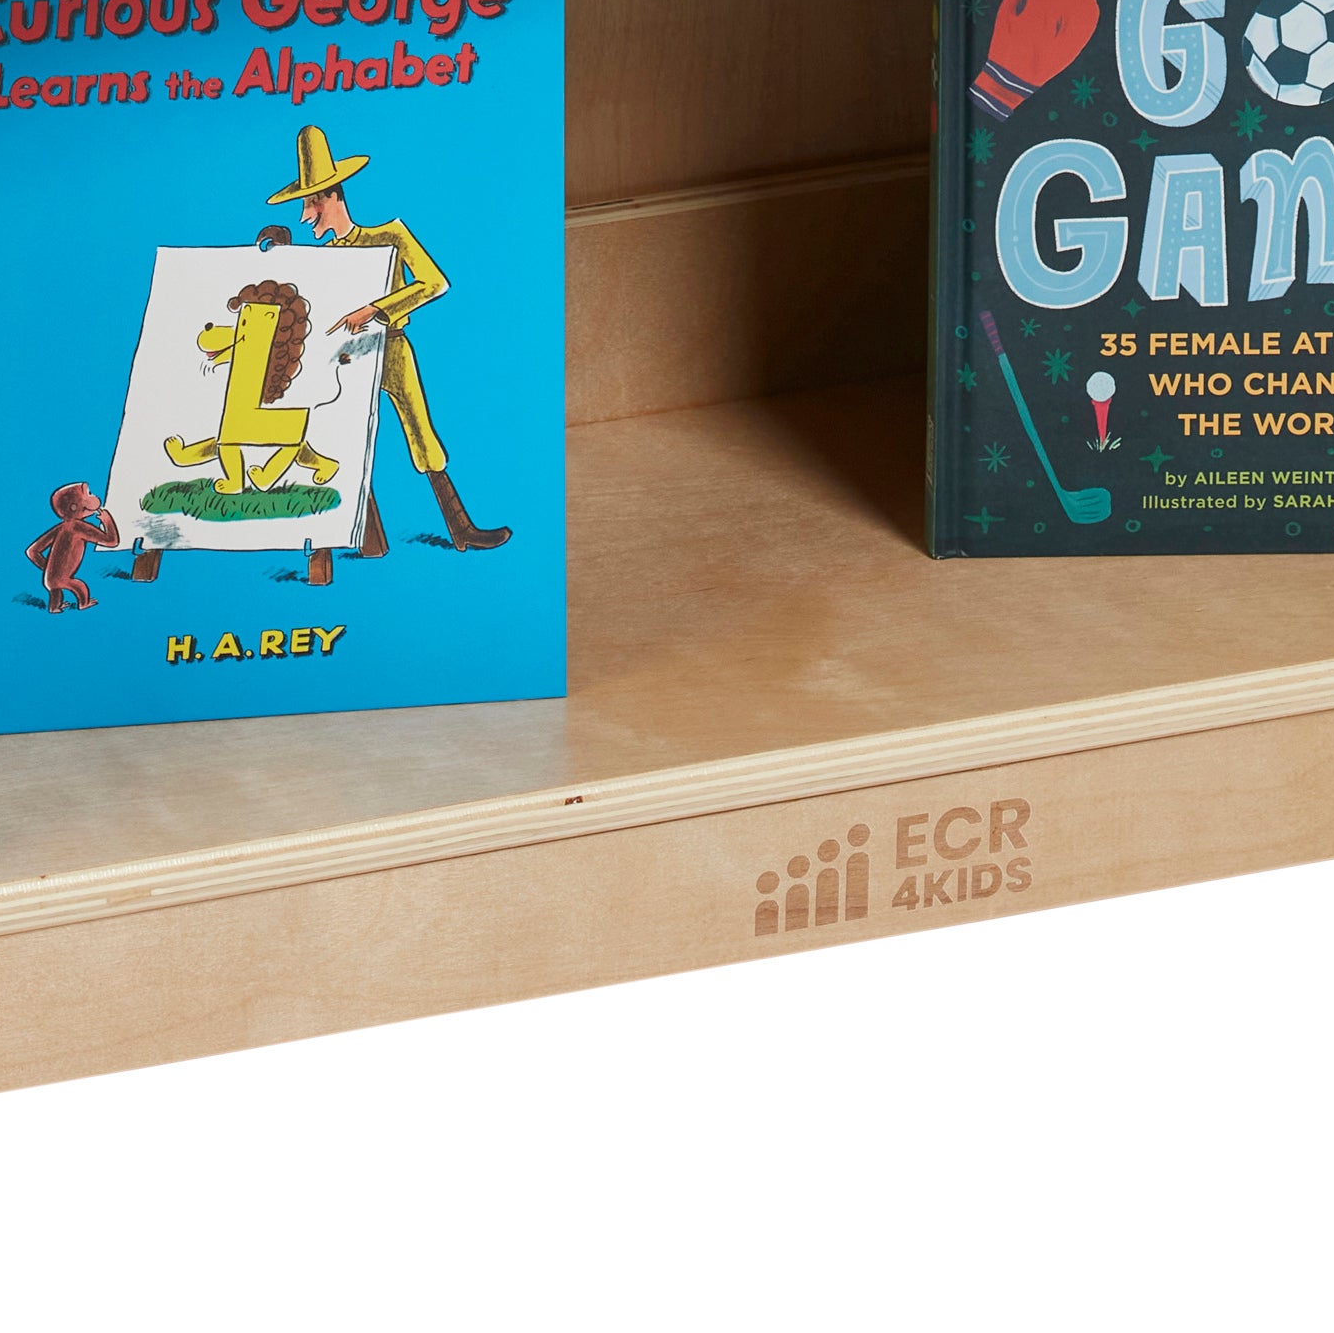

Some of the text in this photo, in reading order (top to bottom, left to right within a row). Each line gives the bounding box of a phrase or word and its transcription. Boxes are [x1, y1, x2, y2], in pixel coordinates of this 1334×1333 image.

[166, 70, 221, 100] the
[233, 43, 478, 104] Alphabet
[1100, 333, 1137, 357] 35
[1149, 333, 1282, 357] FEMALE
[1149, 374, 1232, 396] WHO
[1178, 414, 1241, 437] THE
[1165, 471, 1187, 488] by
[1195, 471, 1264, 485] AILEEN
[1143, 494, 1238, 510] Illustrated
[1244, 494, 1266, 512] by
[896, 798, 1031, 869] ECR
[892, 857, 1032, 911] 4KIDS
